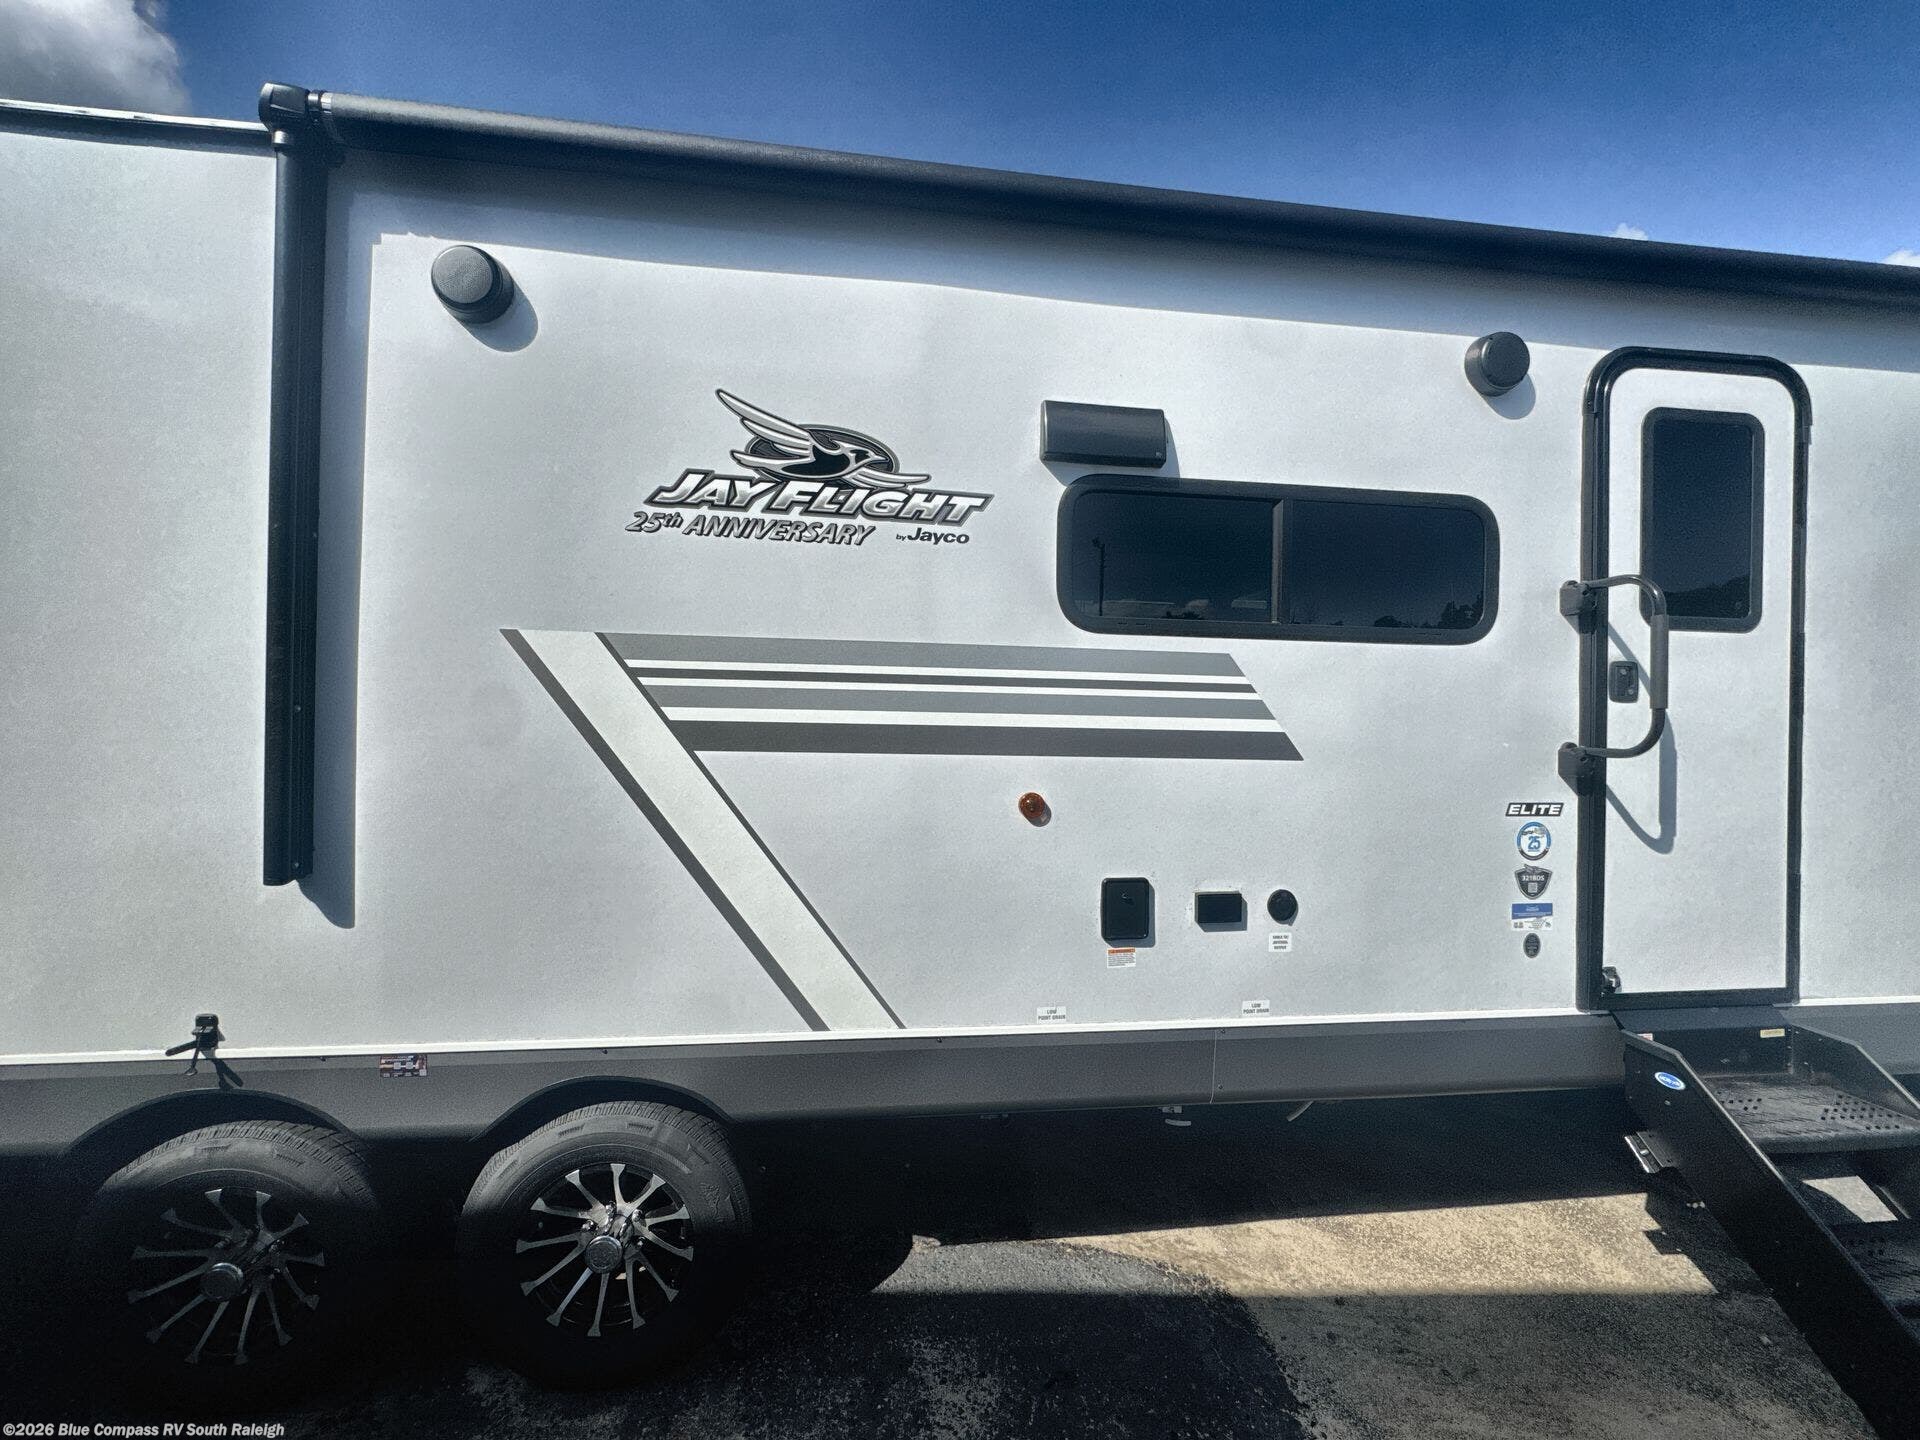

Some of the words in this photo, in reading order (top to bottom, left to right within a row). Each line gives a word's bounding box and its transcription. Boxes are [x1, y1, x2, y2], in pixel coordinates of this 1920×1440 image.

[648, 470, 776, 510] JAY
[765, 480, 990, 525] FLIGHT
[625, 510, 684, 533] 25th
[682, 514, 876, 546] ANNIVERSARY
[896, 533, 907, 541] by
[907, 527, 970, 545] Jayco
[1507, 804, 1562, 815] ELITE
[1528, 835, 1541, 850] 25
